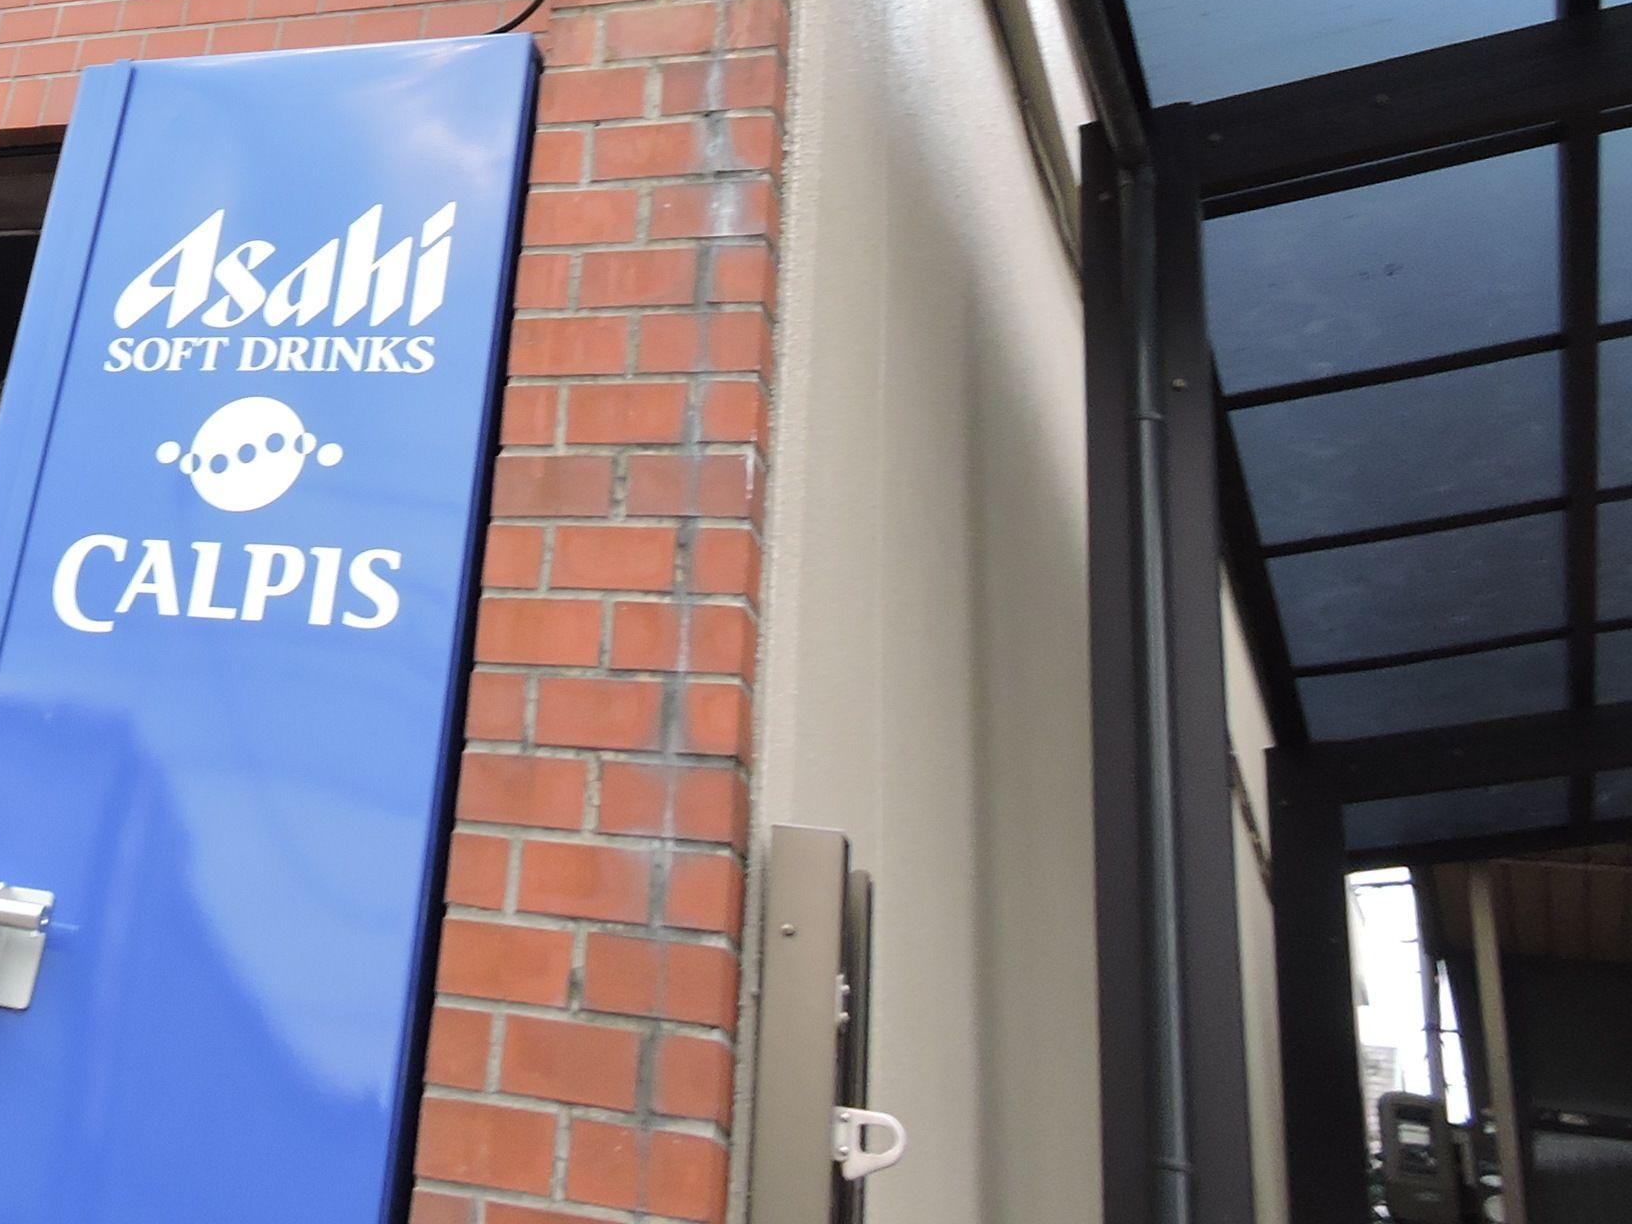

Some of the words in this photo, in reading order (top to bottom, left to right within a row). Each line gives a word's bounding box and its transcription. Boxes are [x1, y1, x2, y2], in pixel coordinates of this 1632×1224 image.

[113, 200, 457, 330] Asahi
[103, 336, 230, 373] SOFT
[235, 335, 436, 374] DRINKS
[51, 533, 403, 634] CALPIS
